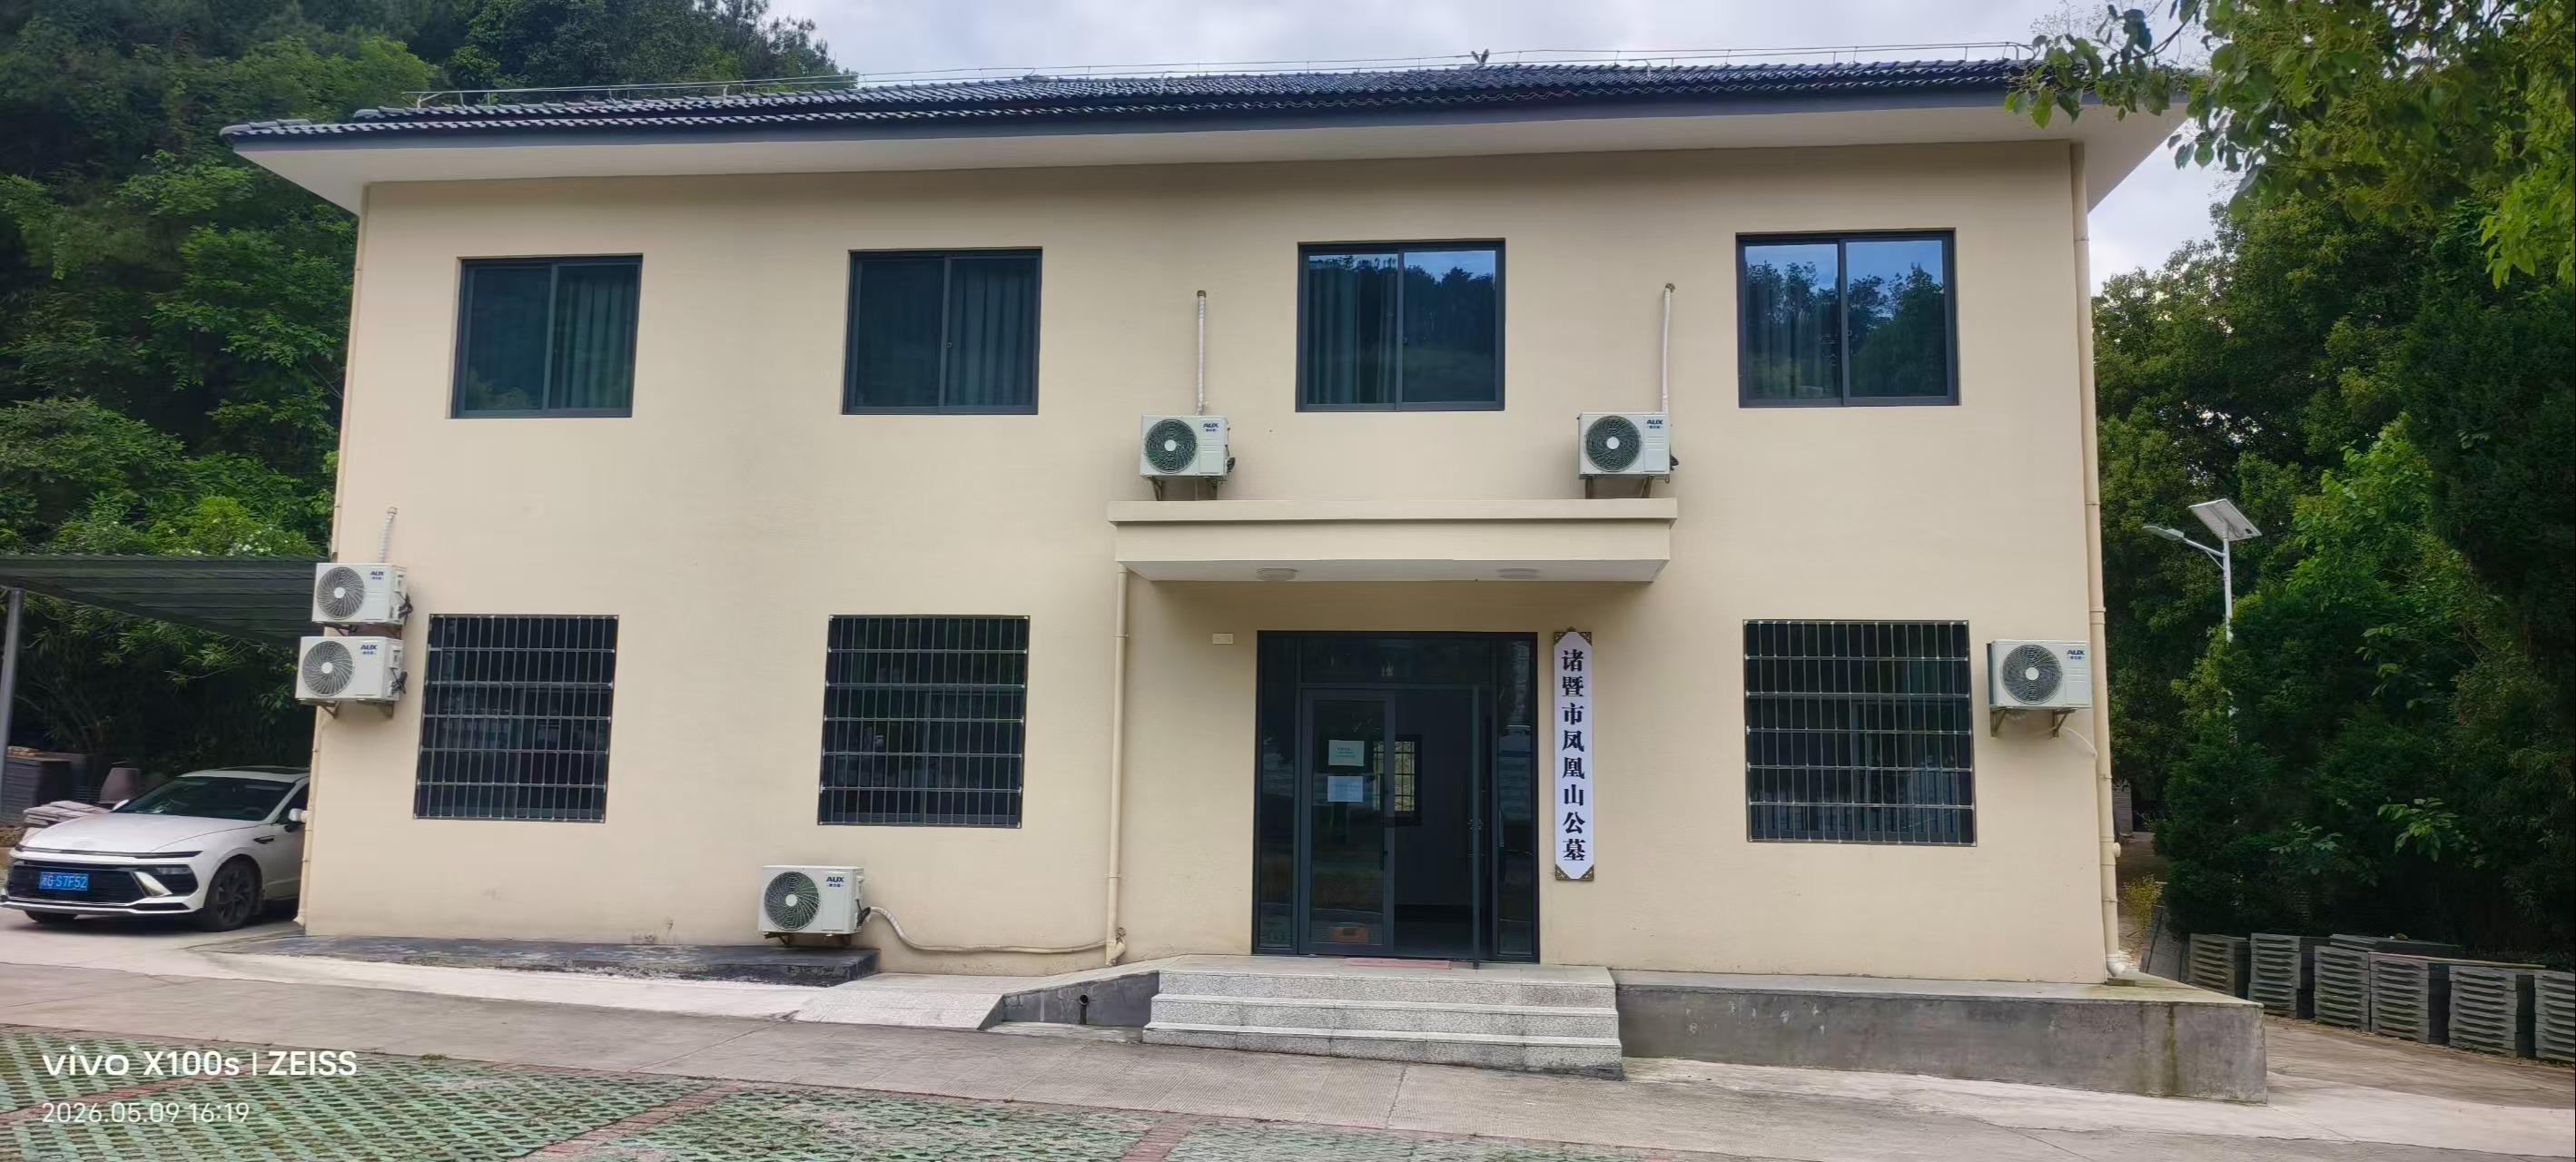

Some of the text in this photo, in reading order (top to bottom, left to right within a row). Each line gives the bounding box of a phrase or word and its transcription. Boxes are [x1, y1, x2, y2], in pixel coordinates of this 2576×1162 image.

[1561, 649, 1586, 862] 诸暨市凤凰山公墓
